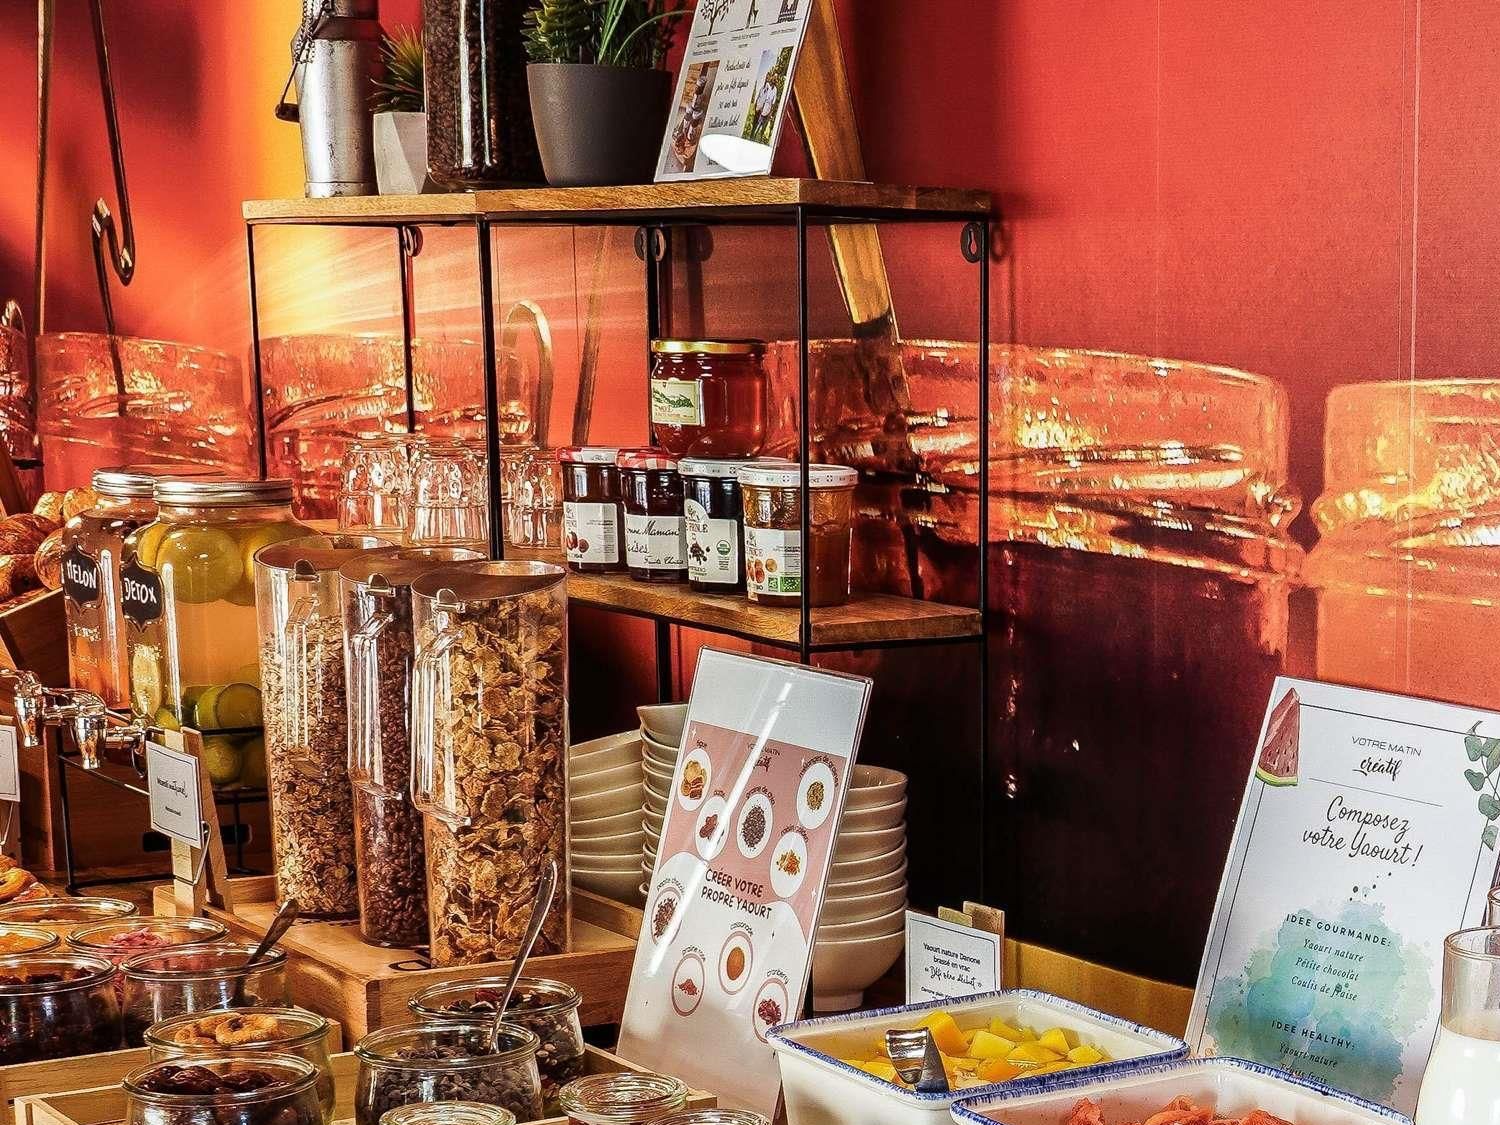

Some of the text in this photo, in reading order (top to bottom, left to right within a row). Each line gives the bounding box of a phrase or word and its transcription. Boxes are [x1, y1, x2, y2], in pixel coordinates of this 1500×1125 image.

[642, 520, 680, 536] Maman
[66, 559, 97, 589] MELON
[123, 577, 157, 604] DETOX
[1352, 736, 1422, 757] VOTRE MATIN
[1352, 757, 1402, 781] créatif
[1327, 796, 1411, 843] Composez
[1303, 826, 1346, 851] votre
[1349, 824, 1412, 865] Yaourt
[705, 867, 732, 887] CRÉER
[735, 878, 763, 897] VOTRE
[701, 886, 733, 907] PROPRE
[736, 896, 773, 919] YAOURT
[1286, 914, 1391, 946] IDEE GOURMANDE:
[1304, 938, 1364, 962] Yaourt nature
[1323, 964, 1359, 981] chocolat
[1291, 976, 1358, 1001] Coulis de fraise
[1271, 1020, 1355, 1050] IDEE HEALTHY:
[1280, 1042, 1338, 1068] Yaourt nature
